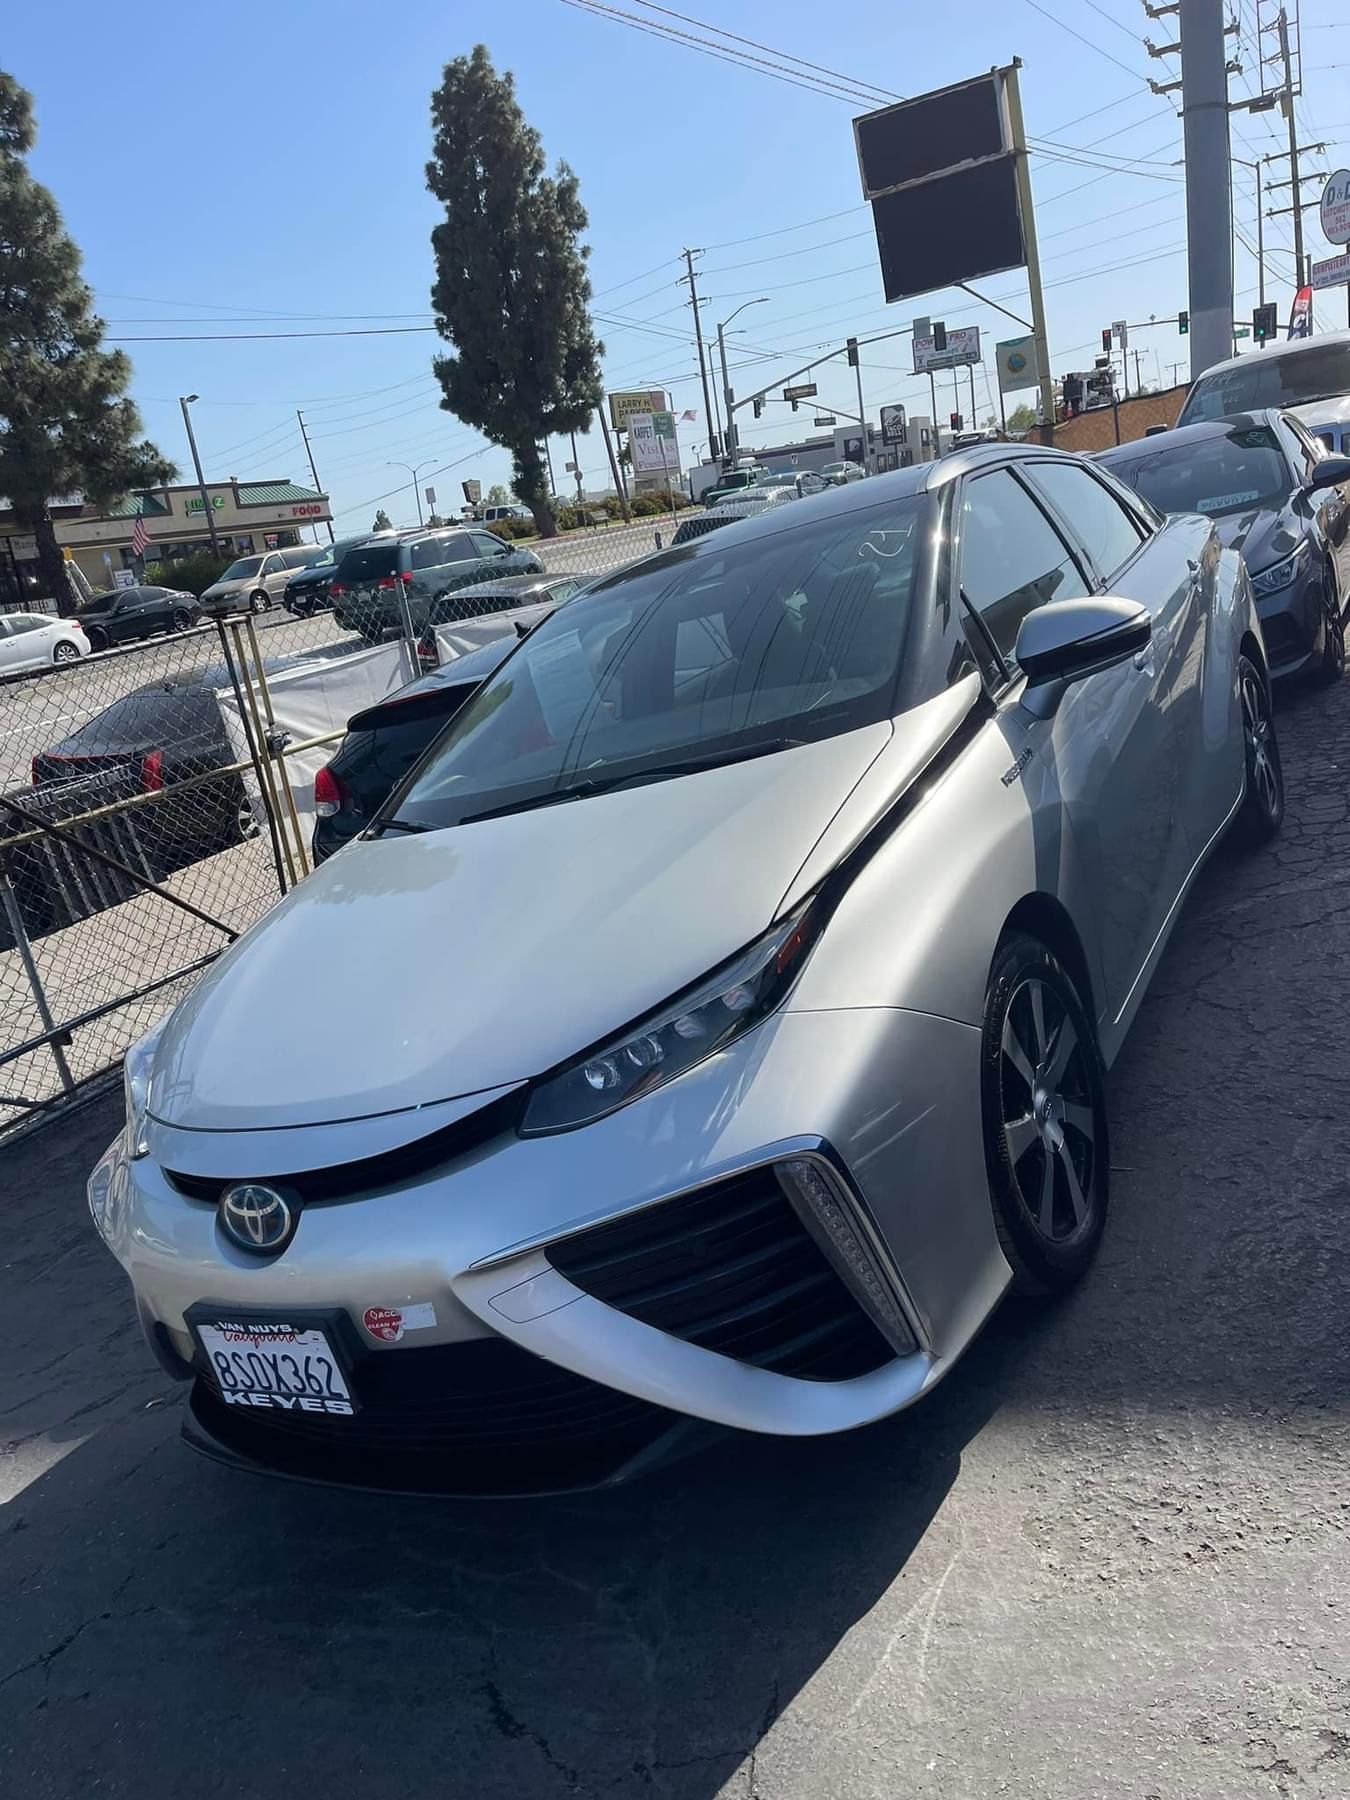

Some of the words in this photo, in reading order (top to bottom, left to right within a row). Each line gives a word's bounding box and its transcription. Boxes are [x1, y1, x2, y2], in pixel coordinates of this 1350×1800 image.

[1327, 186, 1335, 206] D
[617, 399, 641, 409] LARRY
[292, 504, 321, 516] FOOD
[217, 1321, 245, 1332] VAN
[248, 1324, 293, 1333] NUYS
[368, 1321, 390, 1329] CLEAN
[222, 1390, 354, 1415] KEYES
